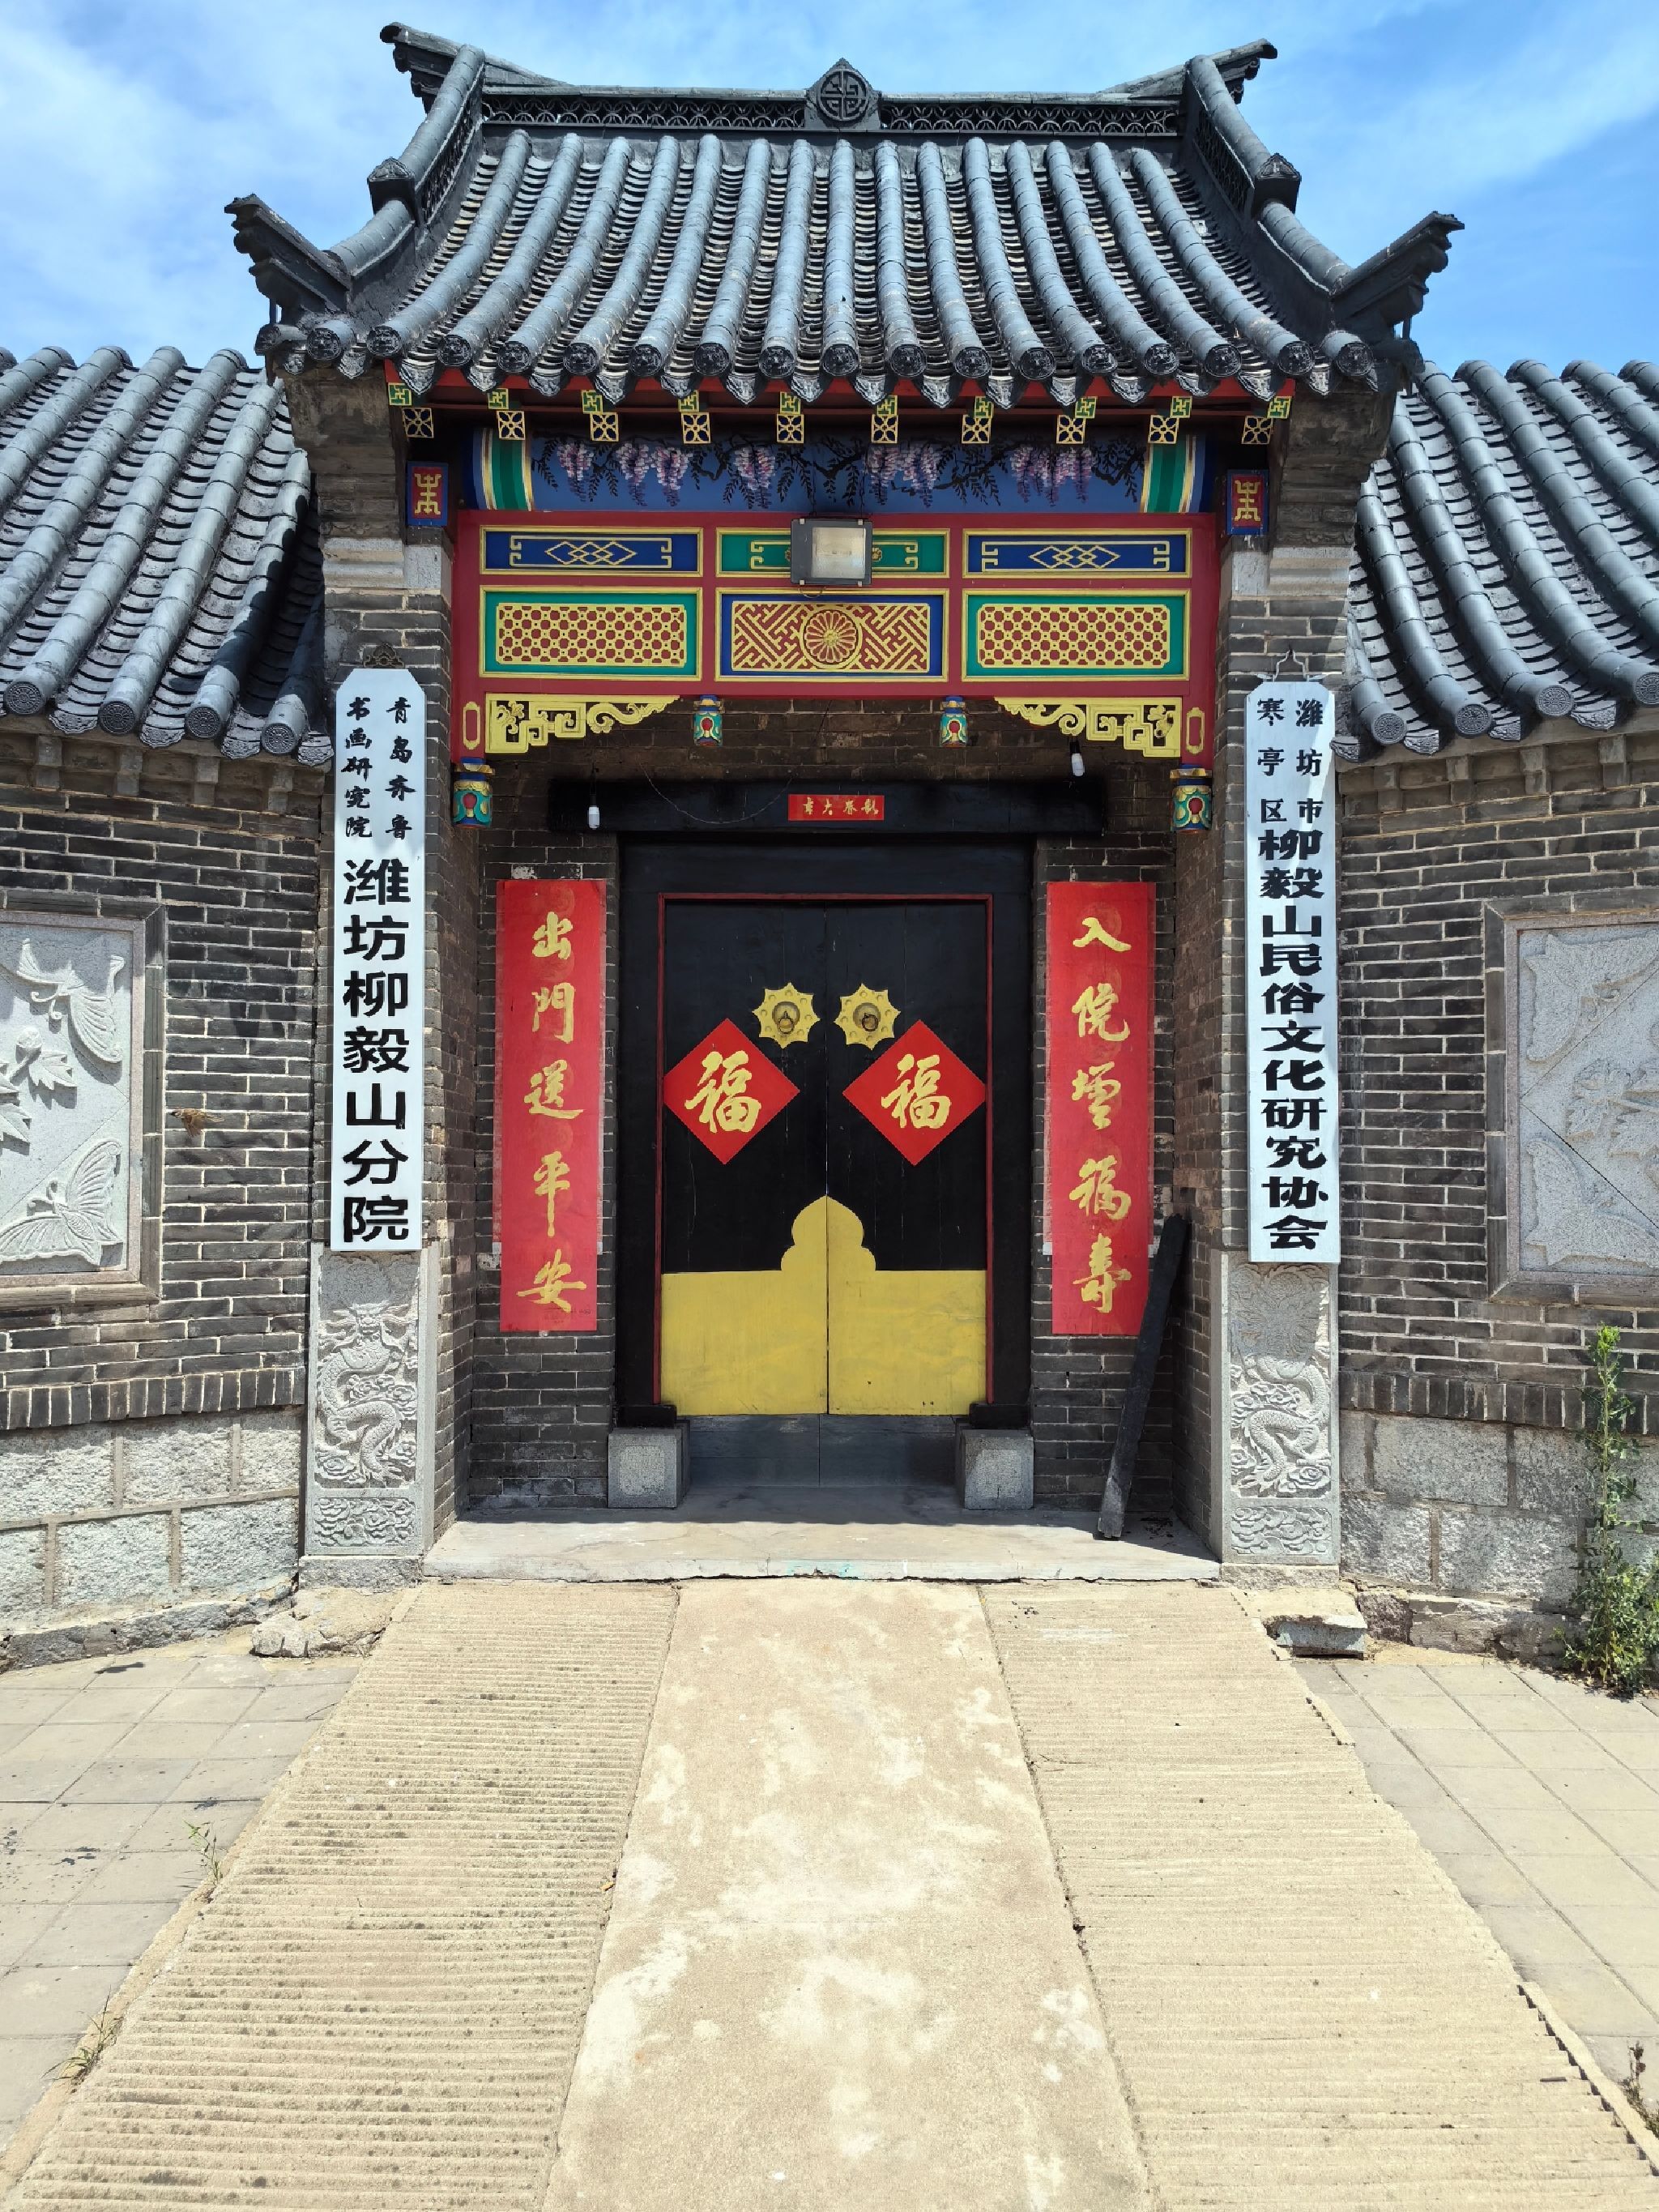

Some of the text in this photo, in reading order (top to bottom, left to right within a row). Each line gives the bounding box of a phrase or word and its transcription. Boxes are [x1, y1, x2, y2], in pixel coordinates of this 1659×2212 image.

[340, 696, 373, 838] 书画研究院
[1256, 698, 1287, 823] 寒亭区
[1295, 699, 1324, 824] 潍坊市
[343, 859, 412, 1245] 潍坊柳毅山分院
[684, 1049, 762, 1134] 福
[881, 1053, 952, 1129] 福
[1258, 828, 1329, 1250] 柳毅山民俗文化研究协会
